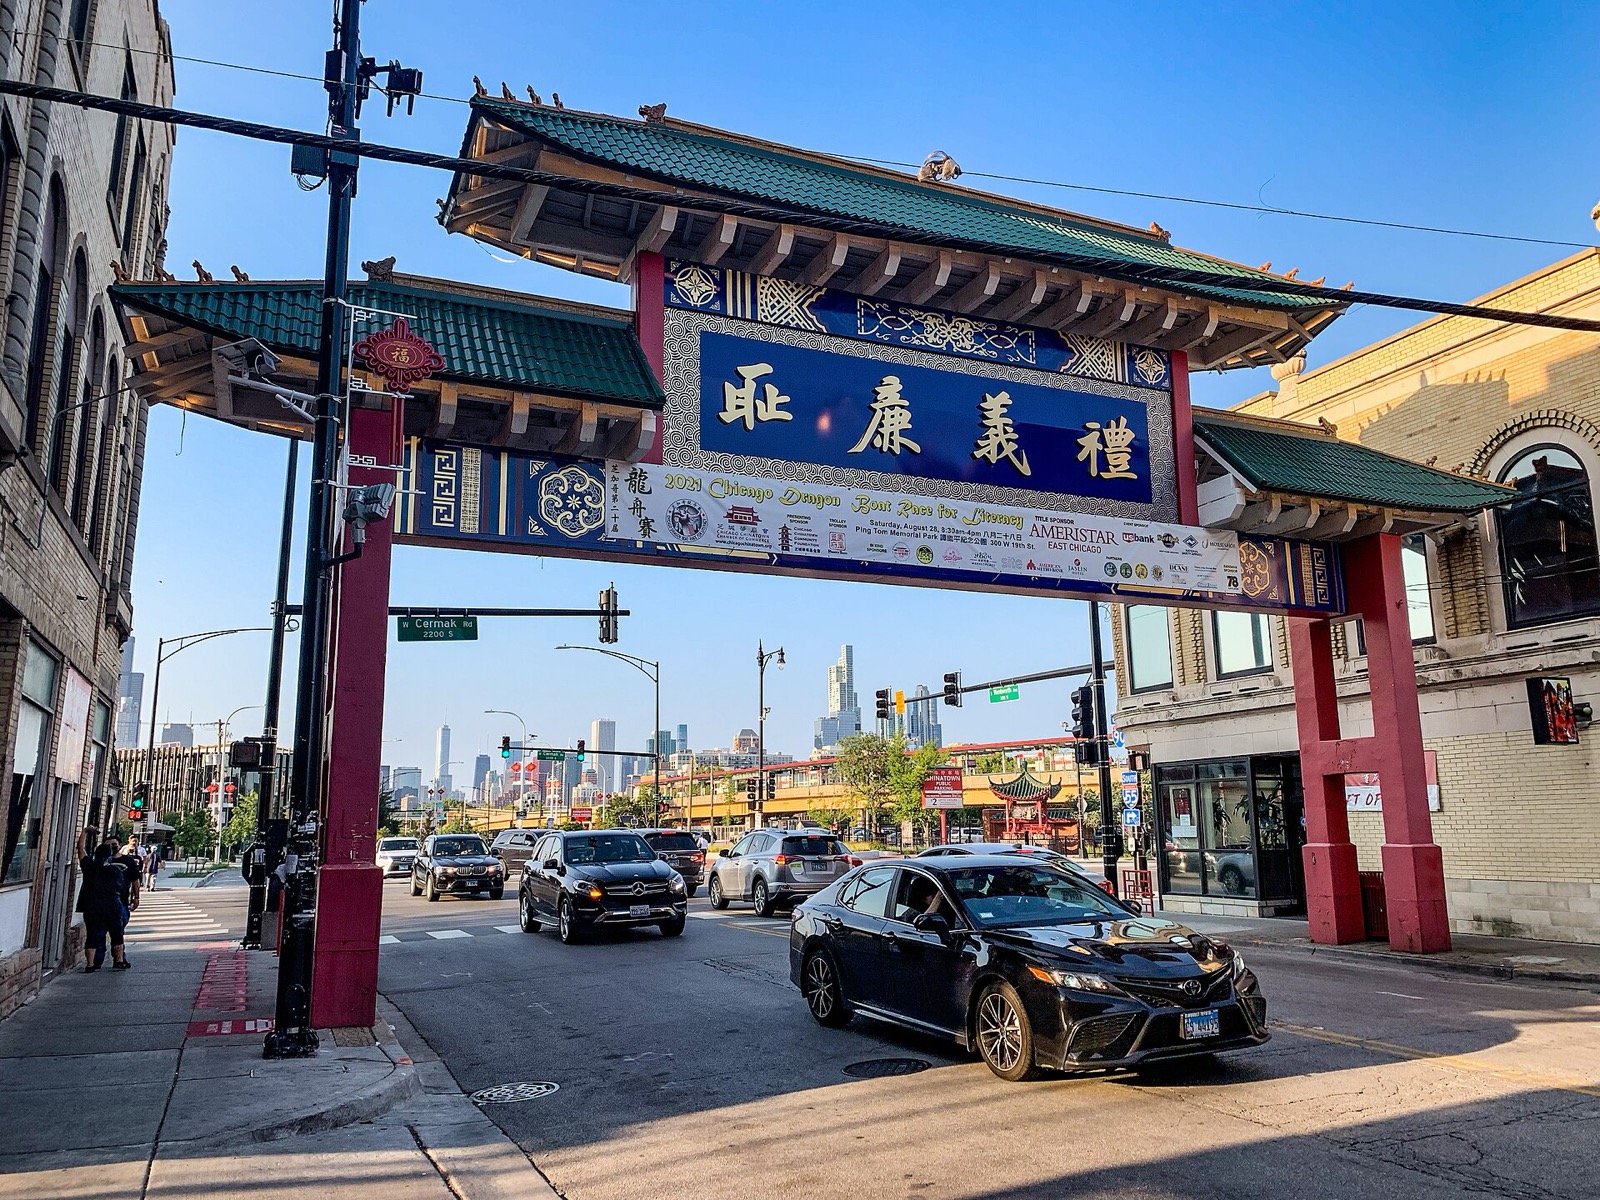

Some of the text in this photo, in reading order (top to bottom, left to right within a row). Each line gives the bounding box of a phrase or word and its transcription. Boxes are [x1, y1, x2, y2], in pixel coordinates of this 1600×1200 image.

[391, 348, 410, 363] 福
[624, 467, 657, 538] 龍舟賽
[665, 473, 1024, 530] 2021 Chicago Dragon Boat Race for Literacy
[1050, 517, 1075, 525] SPONSOR
[855, 526, 871, 535] Ping
[890, 529, 921, 539] Memorial
[870, 519, 902, 529] Saturday,
[904, 523, 928, 533] August
[983, 531, 1022, 542] 八月二十八日
[1029, 523, 1119, 546] AMERISTAR
[1048, 541, 1101, 554] EAST CHICAGO
[1226, 575, 1239, 588] 78
[415, 618, 457, 628] Cermak
[448, 630, 454, 638] S
[1122, 775, 1137, 783] SOUTH
[1124, 790, 1138, 801] 55
